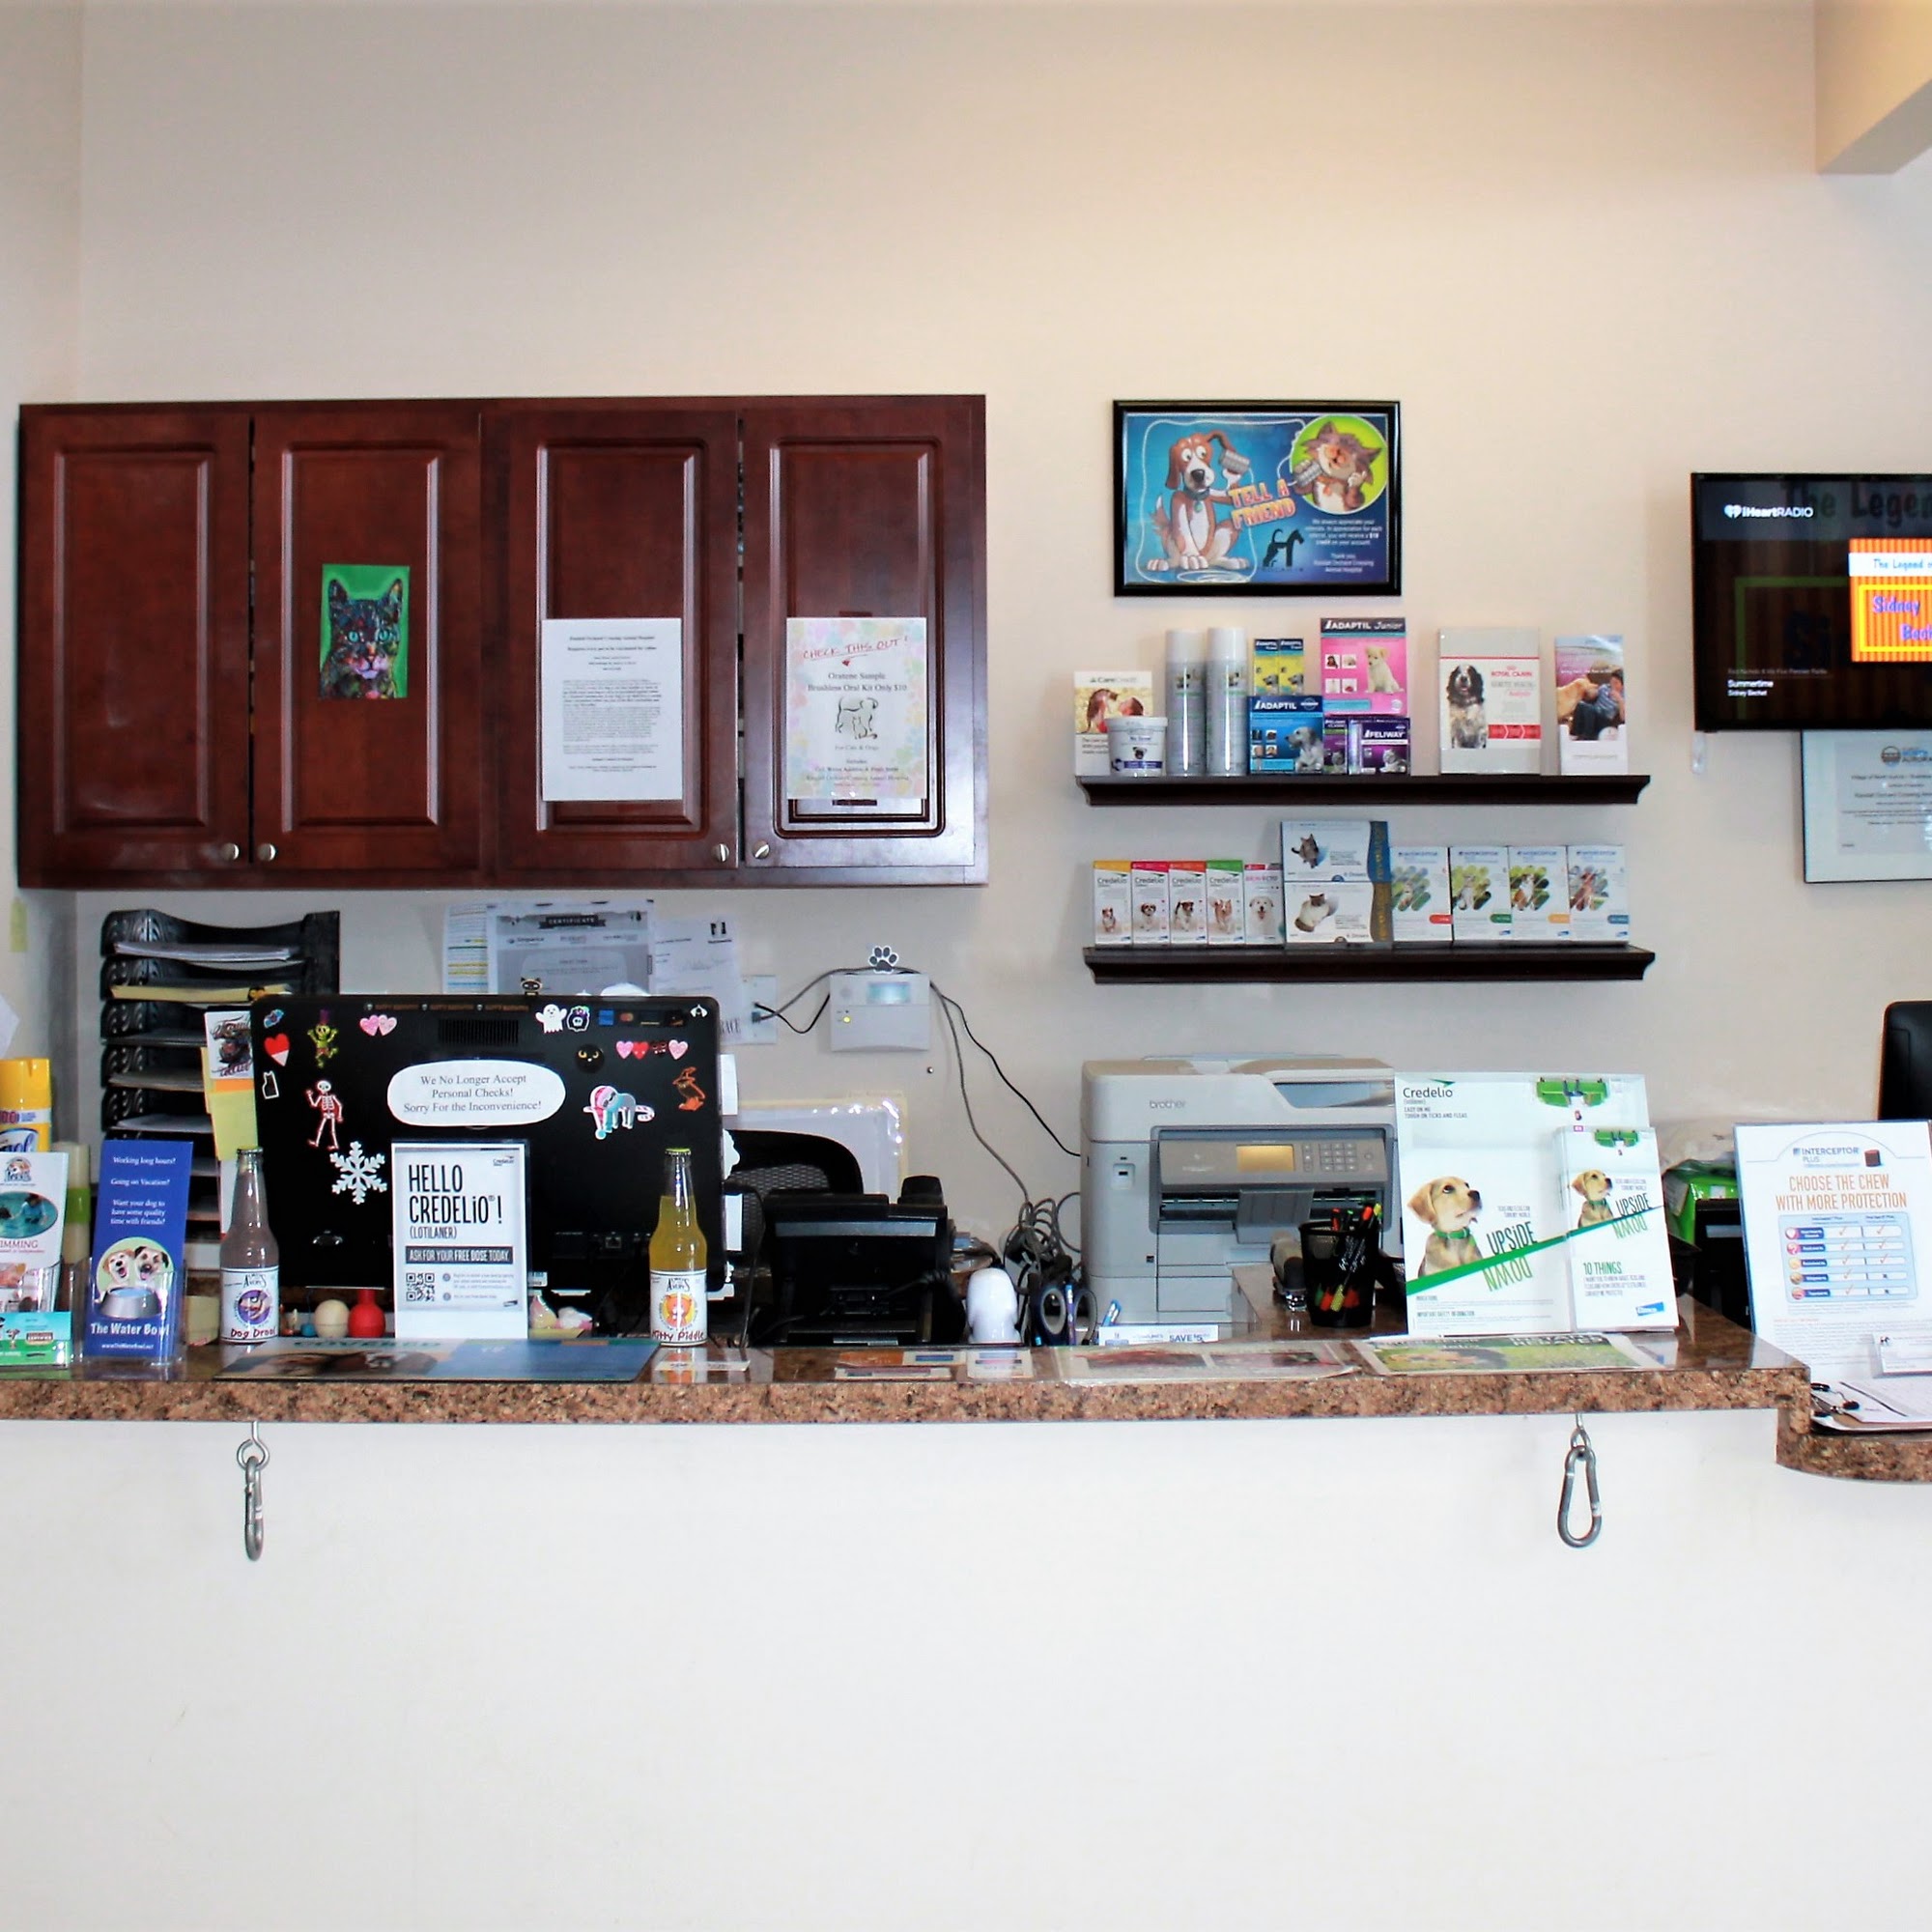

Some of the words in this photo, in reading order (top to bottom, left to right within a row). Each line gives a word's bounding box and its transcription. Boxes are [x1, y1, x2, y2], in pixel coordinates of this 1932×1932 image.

[1228, 482, 1273, 509] TELL
[1277, 478, 1290, 497] A
[1231, 497, 1295, 530] FRIEND
[1742, 505, 1814, 519] iHeartRADIO
[1872, 596, 1920, 616] Sidney
[804, 648, 839, 659] CHECK
[860, 672, 886, 681] Sample
[874, 684, 892, 693] Only
[1261, 701, 1297, 710] ADAPTIL
[421, 1076, 437, 1085] We
[440, 1076, 453, 1085] No
[456, 1075, 490, 1086] Longer
[493, 1075, 526, 1085] Accept
[432, 1089, 472, 1098] Personal
[474, 1088, 514, 1097] Checks!
[1403, 1087, 1454, 1098] Credelio
[404, 1103, 429, 1115] Sorry
[433, 1103, 448, 1112] For
[451, 1102, 467, 1111] the
[469, 1101, 542, 1112] Inconvenience!
[1150, 1100, 1185, 1109] brother
[1802, 1147, 1860, 1155] INTERCEPTOR
[113, 1156, 139, 1166] Working
[140, 1156, 155, 1166] long
[111, 1179, 130, 1187] Going
[408, 1164, 464, 1193] HELLO
[1789, 1175, 1833, 1191] CHOOSE
[1834, 1175, 1855, 1190] THE
[1858, 1174, 1889, 1189] CHEW
[1776, 1194, 1804, 1210] WITH
[1806, 1194, 1838, 1210] MORE
[1840, 1192, 1908, 1209] PROTECTION
[410, 1226, 458, 1239] (LOTILANER)
[409, 1249, 422, 1262] ASK
[423, 1249, 436, 1262] FOR
[437, 1249, 454, 1262] YOUR
[454, 1249, 469, 1262] FREE
[470, 1249, 488, 1262] DOSE
[1583, 1262, 1593, 1275] 10
[90, 1321, 108, 1334] The
[110, 1322, 142, 1335] Water
[231, 1328, 249, 1340] Dog
[253, 1327, 276, 1338] Drool
[652, 1330, 673, 1342] Kitty
[677, 1329, 704, 1341] Piddle
[1169, 1334, 1193, 1343] SAVE
